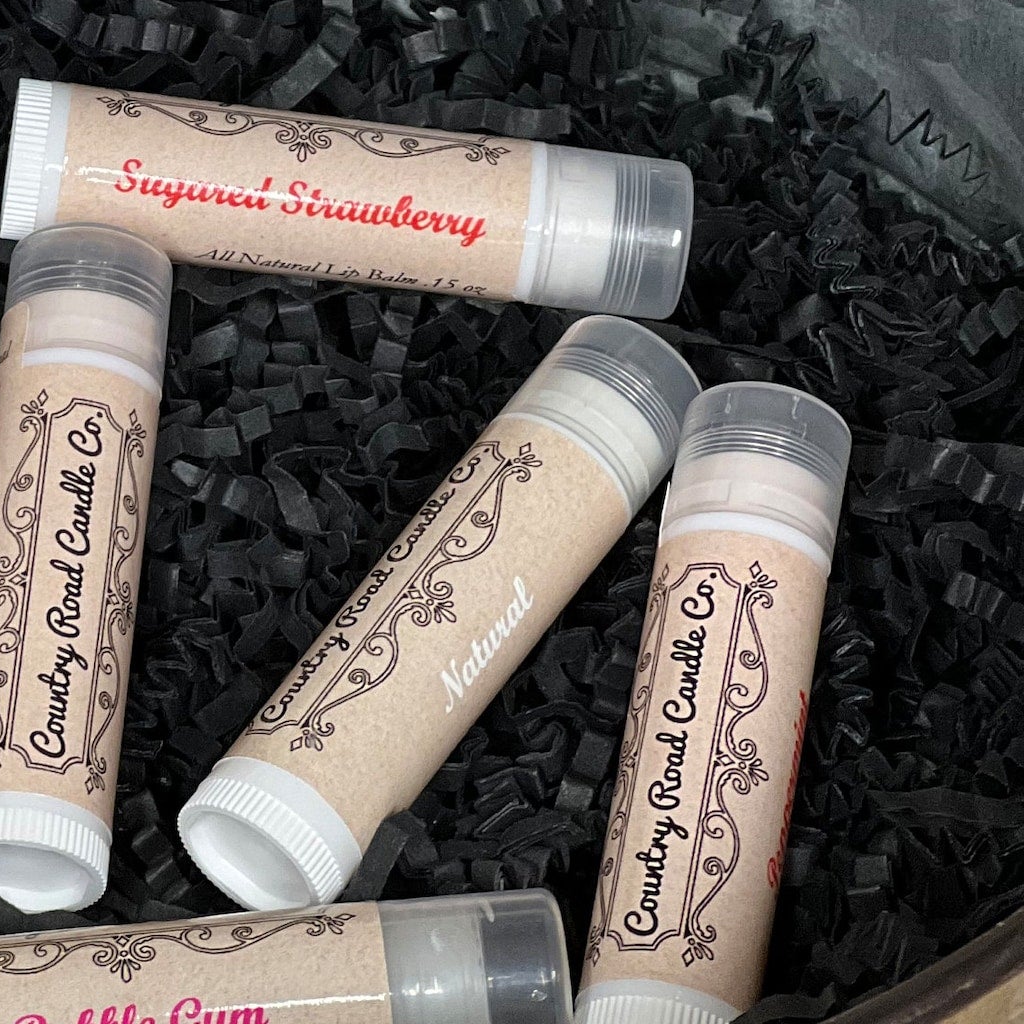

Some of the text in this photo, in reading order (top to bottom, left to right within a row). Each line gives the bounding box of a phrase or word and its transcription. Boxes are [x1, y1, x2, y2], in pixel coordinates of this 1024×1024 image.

[114, 158, 486, 248] Sugared Strawberry
[194, 248, 487, 296] All Natural Lip Balm .15 oz
[29, 411, 104, 759] Country Road Candle Co.
[259, 447, 490, 724] Country Road Candle Co.
[440, 575, 534, 713] Natural
[623, 572, 717, 937] Country Road Candle Co.
